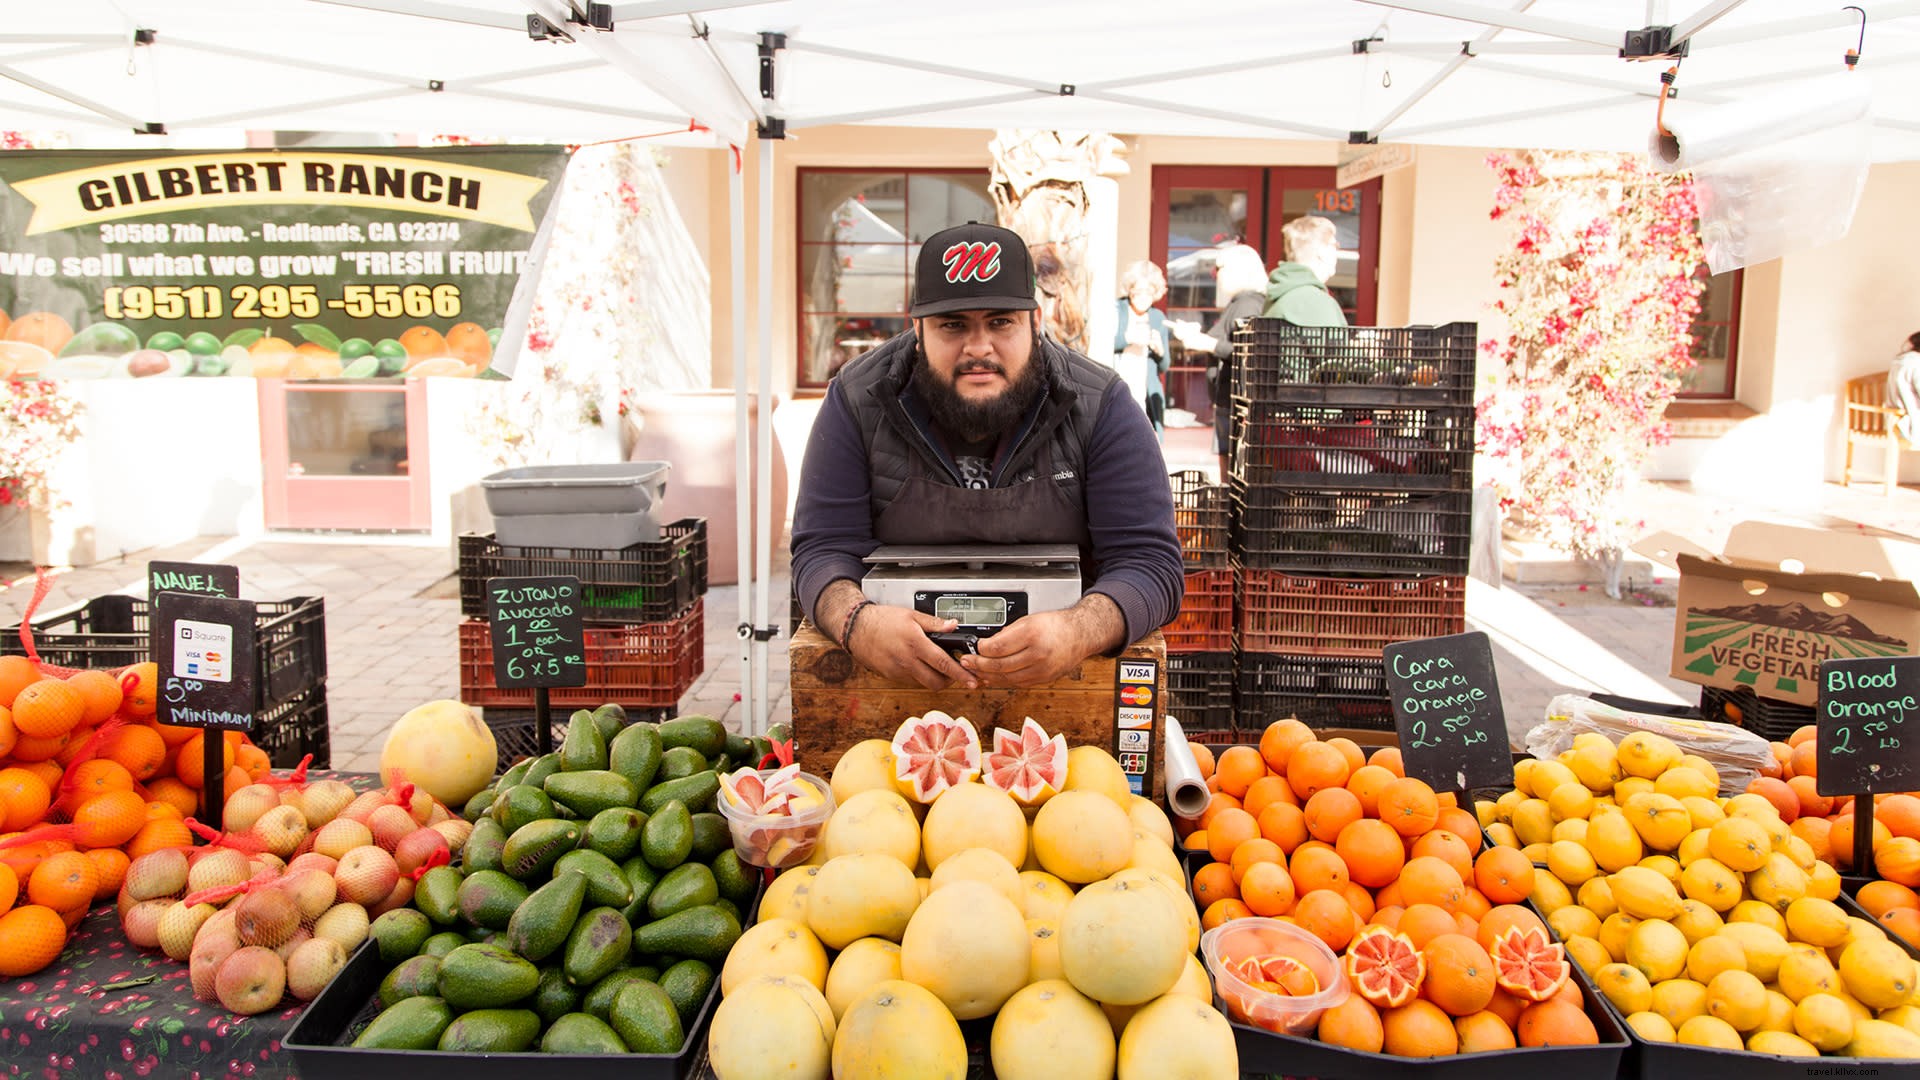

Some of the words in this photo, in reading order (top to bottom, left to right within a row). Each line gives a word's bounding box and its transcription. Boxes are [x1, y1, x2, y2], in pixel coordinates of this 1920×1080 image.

[78, 161, 288, 212] GILBERT
[303, 161, 481, 210] RANCH
[1314, 190, 1354, 212] 103
[99, 223, 170, 243] 30588
[171, 223, 205, 242] 7th
[207, 222, 249, 243] Ave.
[263, 222, 366, 243] Redlands,
[368, 222, 398, 242] CA
[399, 222, 460, 243] 92374
[0, 253, 57, 276] We
[62, 253, 124, 277] sell
[128, 253, 208, 277] what
[210, 255, 255, 277] we
[259, 255, 337, 278] grow
[342, 251, 444, 275] "FRESH
[943, 241, 1001, 283] M
[103, 284, 224, 320] (951)
[230, 284, 321, 319] 295
[327, 284, 462, 319] -5566
[497, 601, 573, 621] Avocado
[194, 630, 226, 642] Square
[503, 624, 526, 647] 1
[1751, 631, 1831, 661] FRESH
[185, 650, 200, 658] VISA
[506, 656, 525, 679] 6
[547, 658, 560, 675] 5
[1126, 668, 1151, 678] VISA
[1393, 654, 1454, 679] Cara
[1827, 664, 1897, 692] Blood
[1413, 674, 1468, 692] cara
[1120, 713, 1151, 721] DISCOVER
[1827, 695, 1919, 724] Orange
[1120, 759, 1144, 768] JCB
